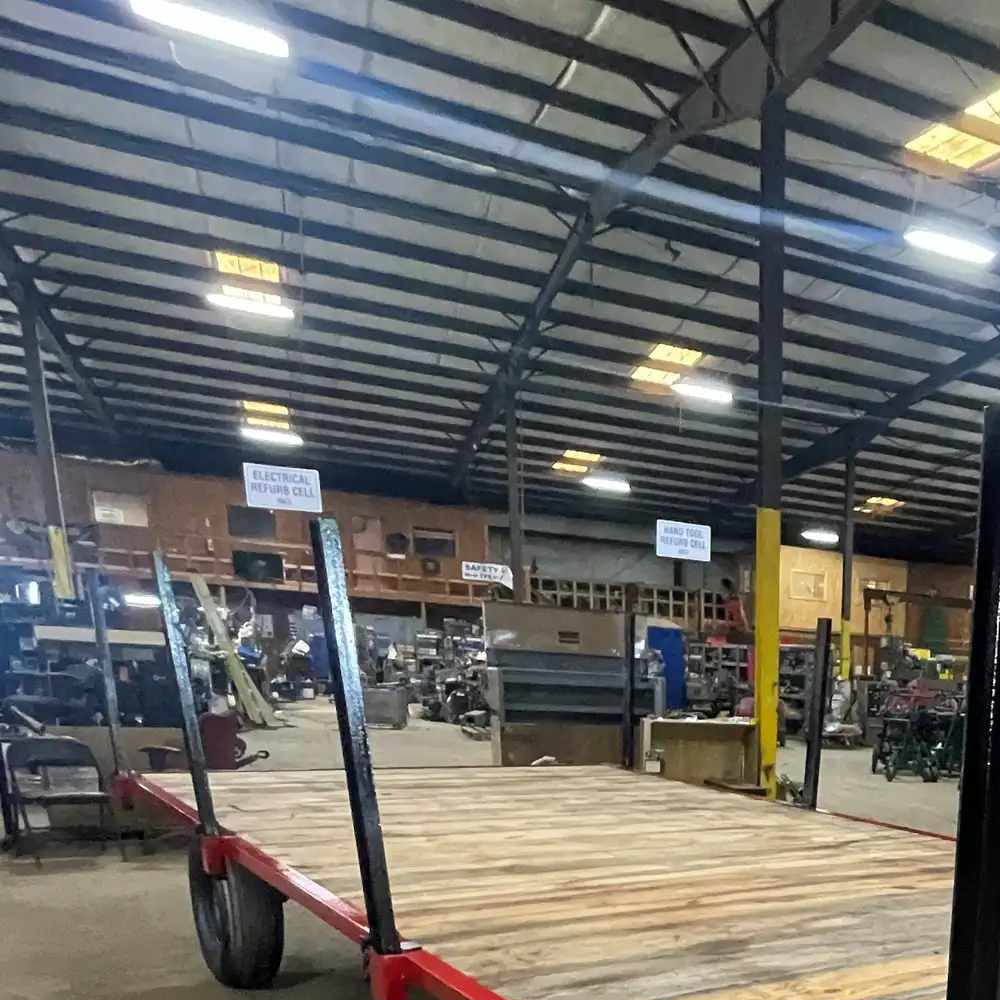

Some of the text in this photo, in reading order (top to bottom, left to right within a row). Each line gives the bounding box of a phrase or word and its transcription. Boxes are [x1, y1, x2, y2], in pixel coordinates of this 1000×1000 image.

[253, 470, 311, 485] ELECTRICAL
[251, 482, 314, 498] REFURB CELL
[664, 524, 684, 536] HAND
[690, 540, 706, 549] CELL
[465, 564, 499, 573] SAFETY
